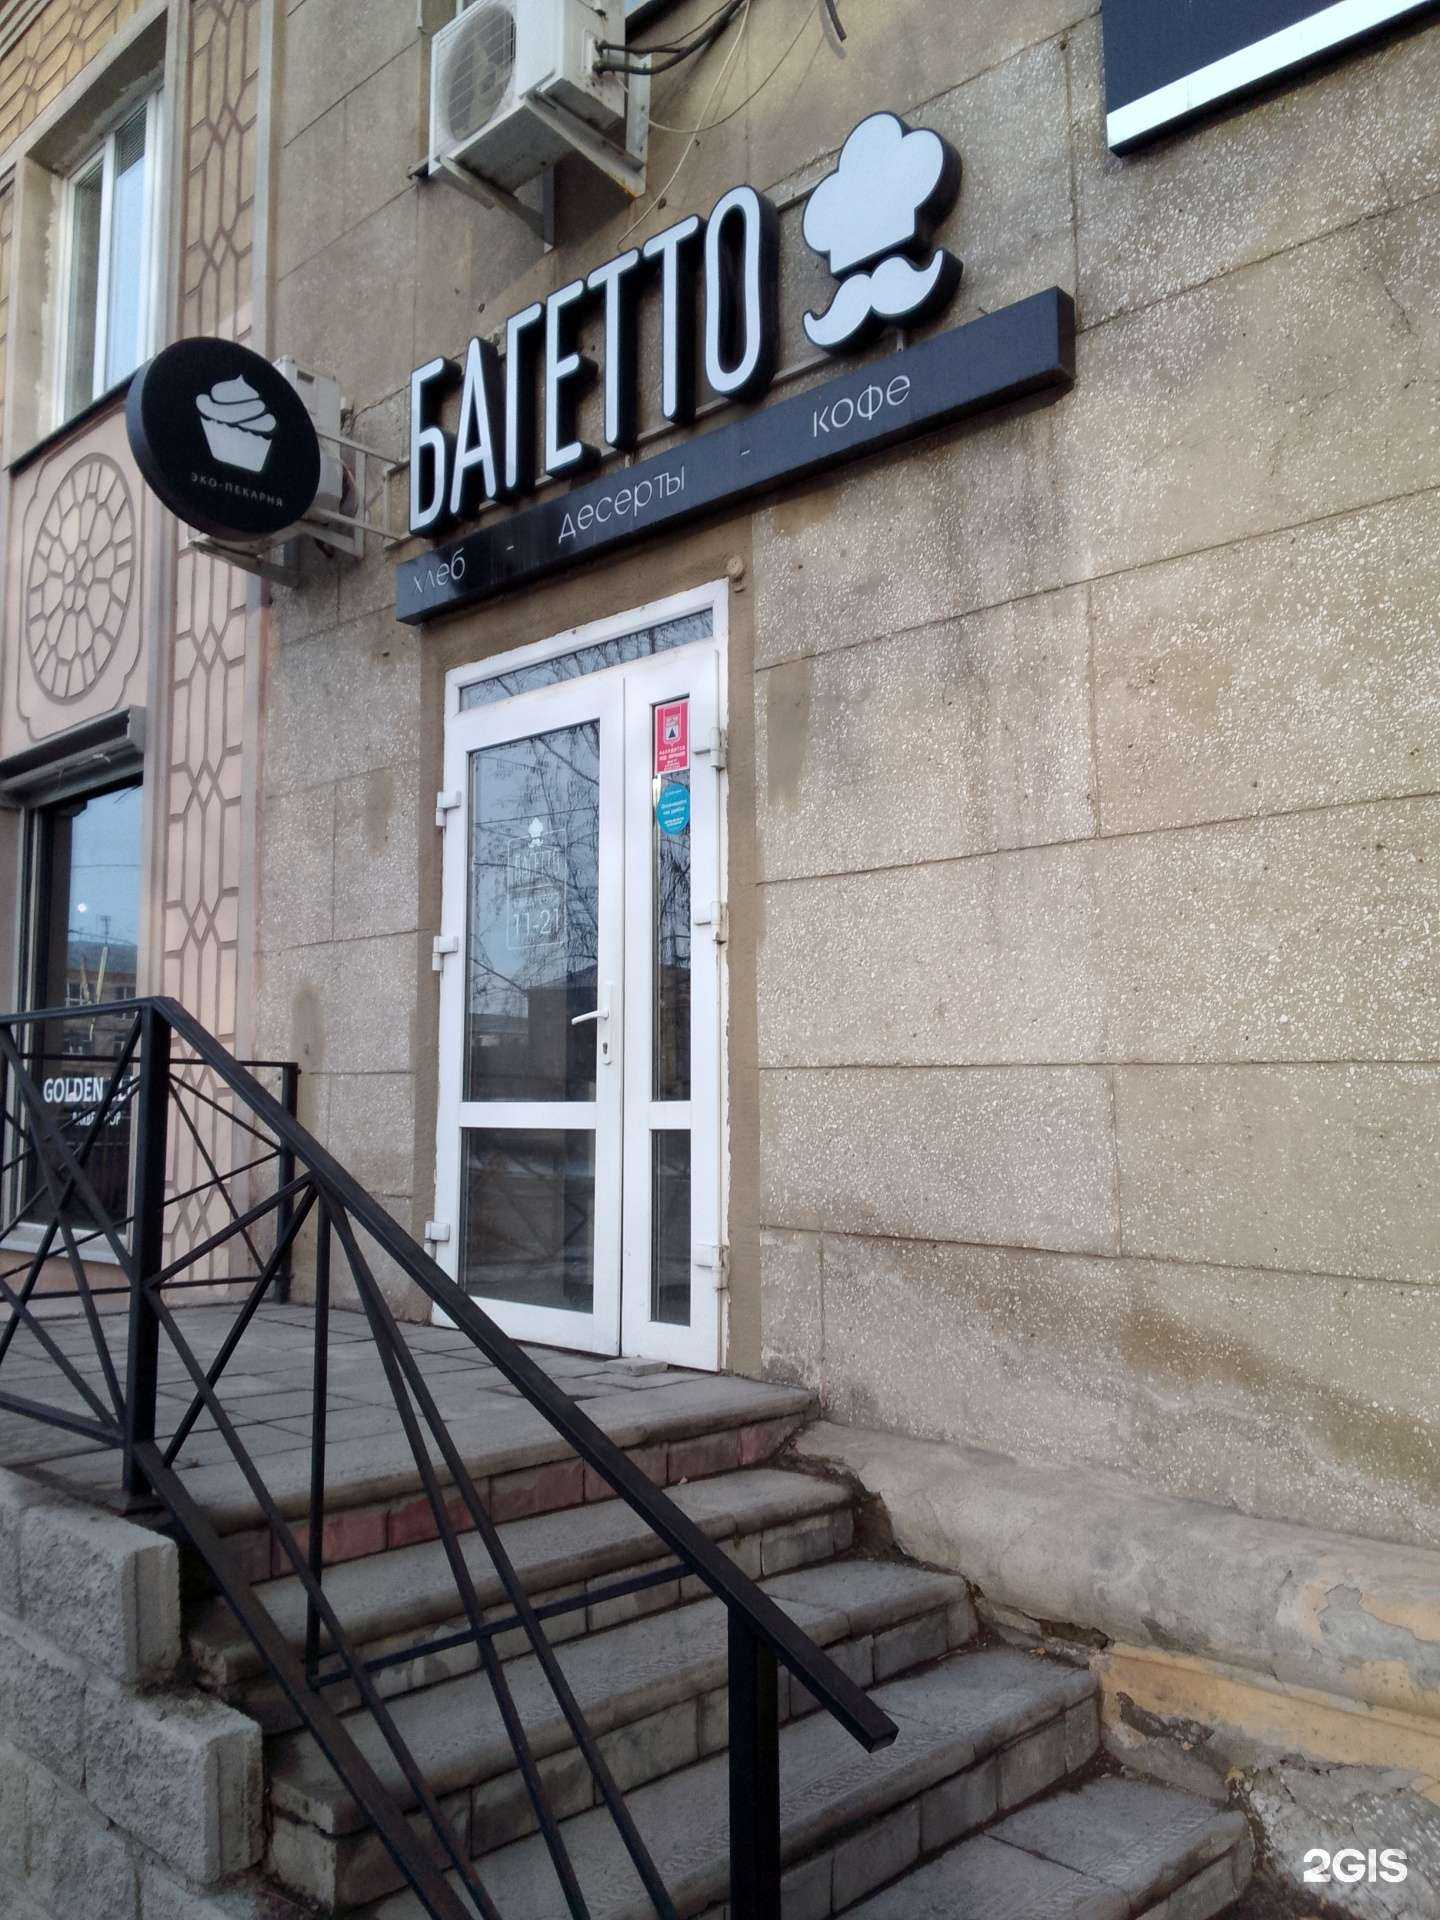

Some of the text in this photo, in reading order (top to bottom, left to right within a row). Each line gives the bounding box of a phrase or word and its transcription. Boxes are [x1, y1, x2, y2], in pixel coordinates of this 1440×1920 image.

[410, 185, 764, 530] БАГЕТТО
[191, 473, 283, 507] ЭКО-ПЕКАРНЯ
[412, 547, 467, 594] хлеб
[558, 464, 686, 544] десерты
[812, 374, 912, 438] кофе
[513, 907, 559, 937] 11-21
[43, 1077, 104, 1104] GOLDEN
